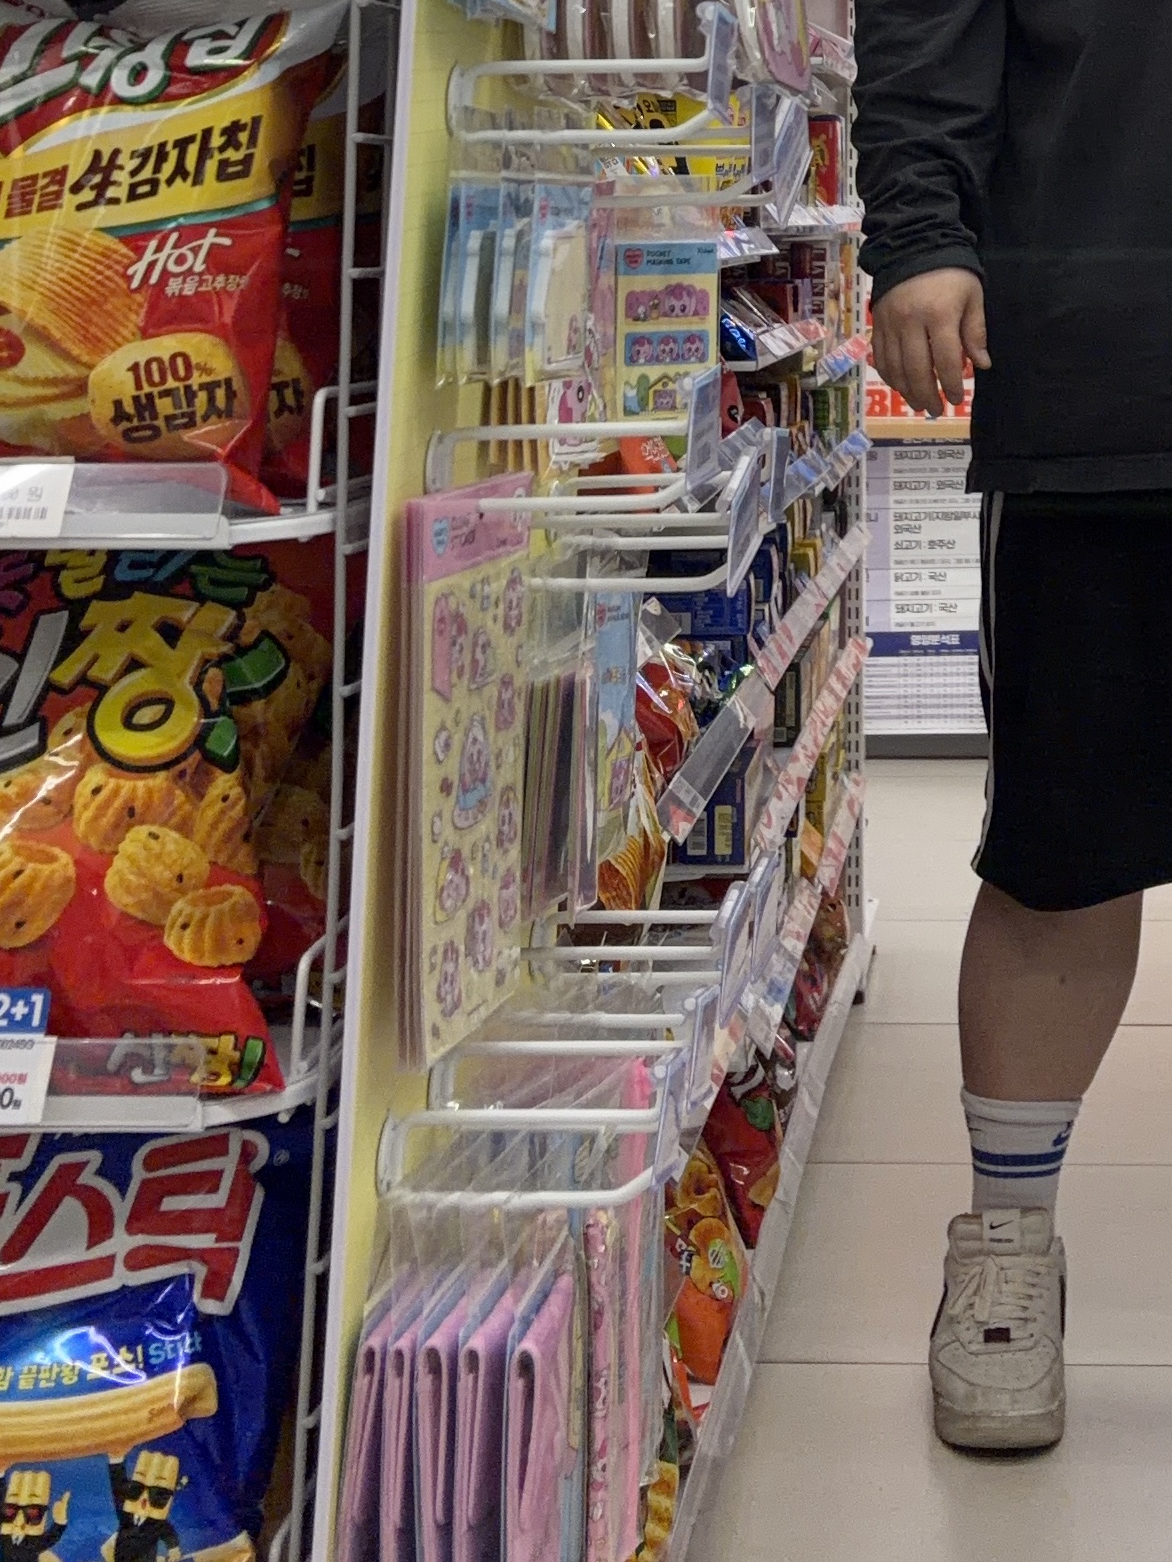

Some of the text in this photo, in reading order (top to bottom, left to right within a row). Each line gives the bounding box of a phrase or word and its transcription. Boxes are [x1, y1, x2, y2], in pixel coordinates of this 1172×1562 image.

[126, 227, 234, 290] Hot
[126, 350, 219, 392] 100%
[111, 376, 239, 445] 생감자
[0, 1130, 264, 1312] 스틱
